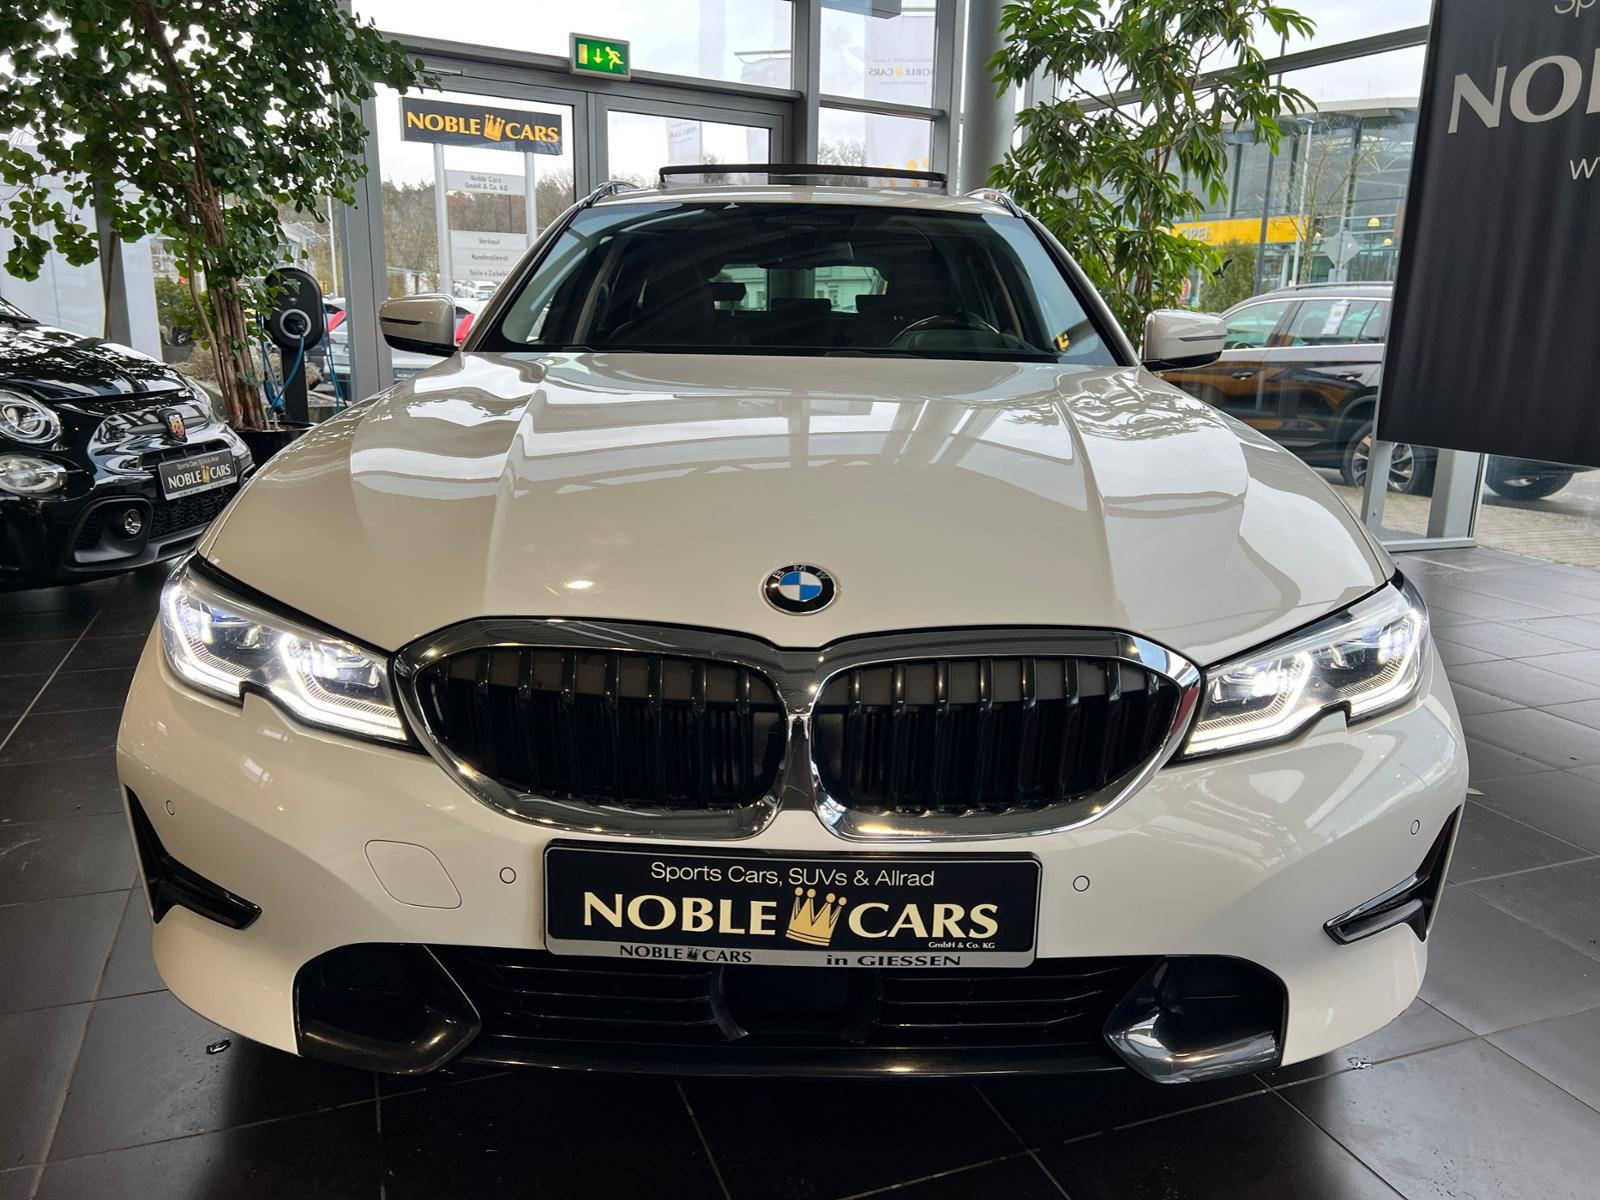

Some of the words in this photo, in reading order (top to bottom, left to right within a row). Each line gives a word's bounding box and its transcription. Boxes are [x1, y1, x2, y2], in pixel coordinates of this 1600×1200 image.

[1447, 48, 1600, 134] NO
[406, 111, 481, 135] NOBLE
[505, 122, 560, 143] CARS
[1569, 156, 1600, 180] w
[167, 470, 202, 489] NOBLE
[209, 463, 231, 479] CARS
[772, 565, 830, 580] BMW
[650, 861, 722, 882] Sports
[728, 865, 783, 887] Cars,
[788, 867, 848, 886] SUVs
[853, 869, 869, 886] &
[874, 869, 935, 887] Allrad
[583, 891, 777, 936] NOBLE
[848, 902, 999, 939] CARS
[619, 944, 683, 960] NOBLE
[702, 949, 753, 963] CARS
[826, 954, 848, 966] in
[857, 955, 962, 967] GIESSEN
[928, 941, 956, 949] GmbH
